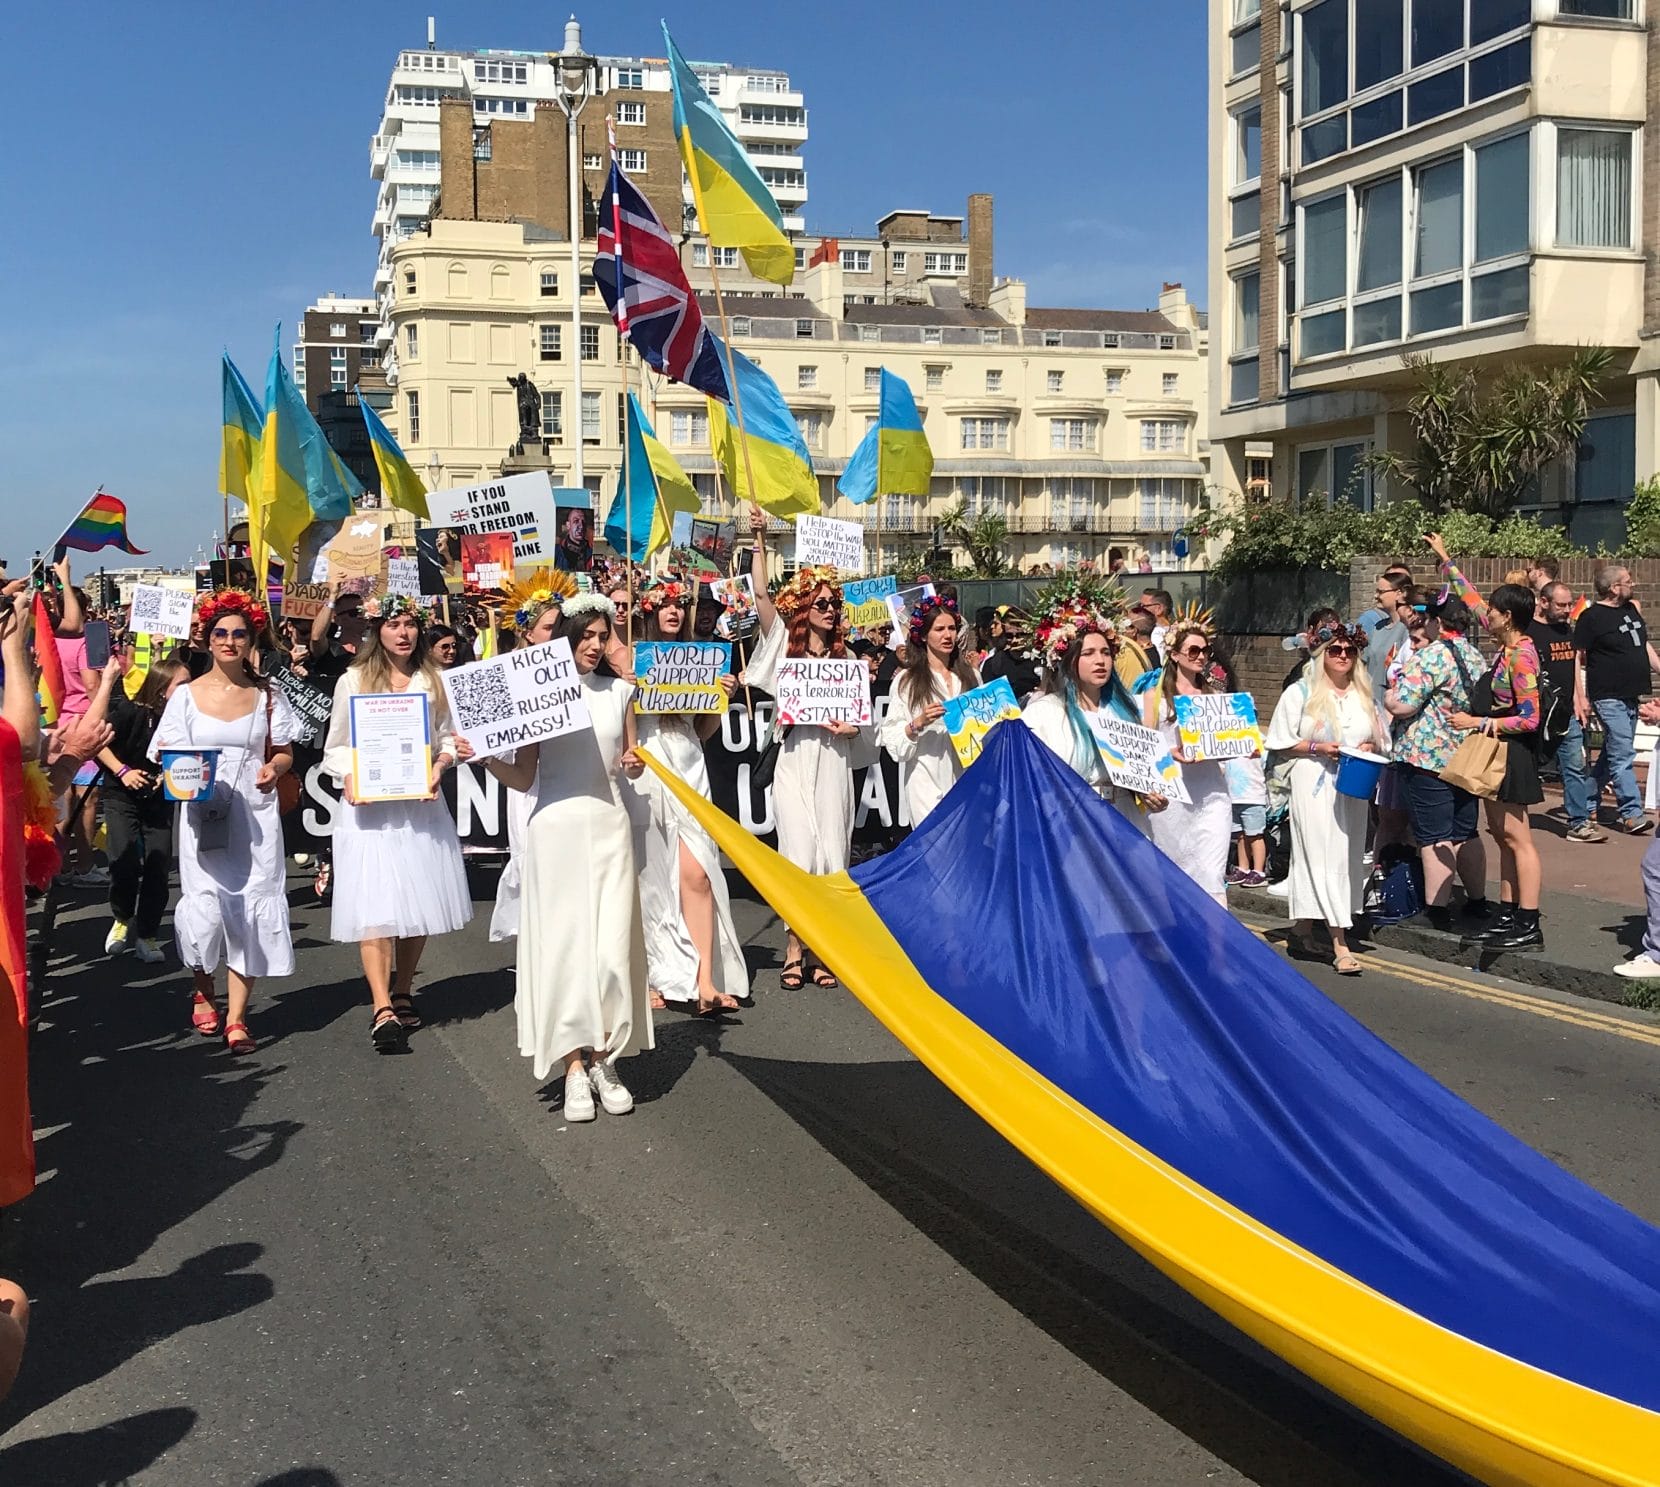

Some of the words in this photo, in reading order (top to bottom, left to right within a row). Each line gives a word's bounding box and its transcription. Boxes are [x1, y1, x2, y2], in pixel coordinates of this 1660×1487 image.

[467, 490, 479, 504] IF
[481, 485, 506, 500] YOU
[471, 500, 511, 519] STAND
[460, 523, 477, 536] OR
[481, 511, 539, 533] FREEDOM,
[806, 516, 827, 529] Help
[809, 527, 834, 539] STOP
[514, 542, 542, 558] AINE
[166, 589, 193, 600] PLEASE
[850, 578, 892, 597] GLORY
[168, 600, 187, 608] SIGN
[144, 621, 183, 635] PETITION
[655, 645, 727, 666] WORLD
[534, 659, 571, 685] OUT
[644, 667, 721, 686] SUPPORT
[312, 692, 333, 708] NO
[780, 684, 790, 698] is
[792, 687, 801, 698] a
[957, 690, 997, 717] PRAY
[1192, 696, 1233, 717] SAVE
[1098, 717, 1160, 743] UKRAINIANS
[1108, 733, 1156, 756] SUPPORT
[1122, 749, 1150, 764] SAME
[1129, 761, 1156, 779] SEX
